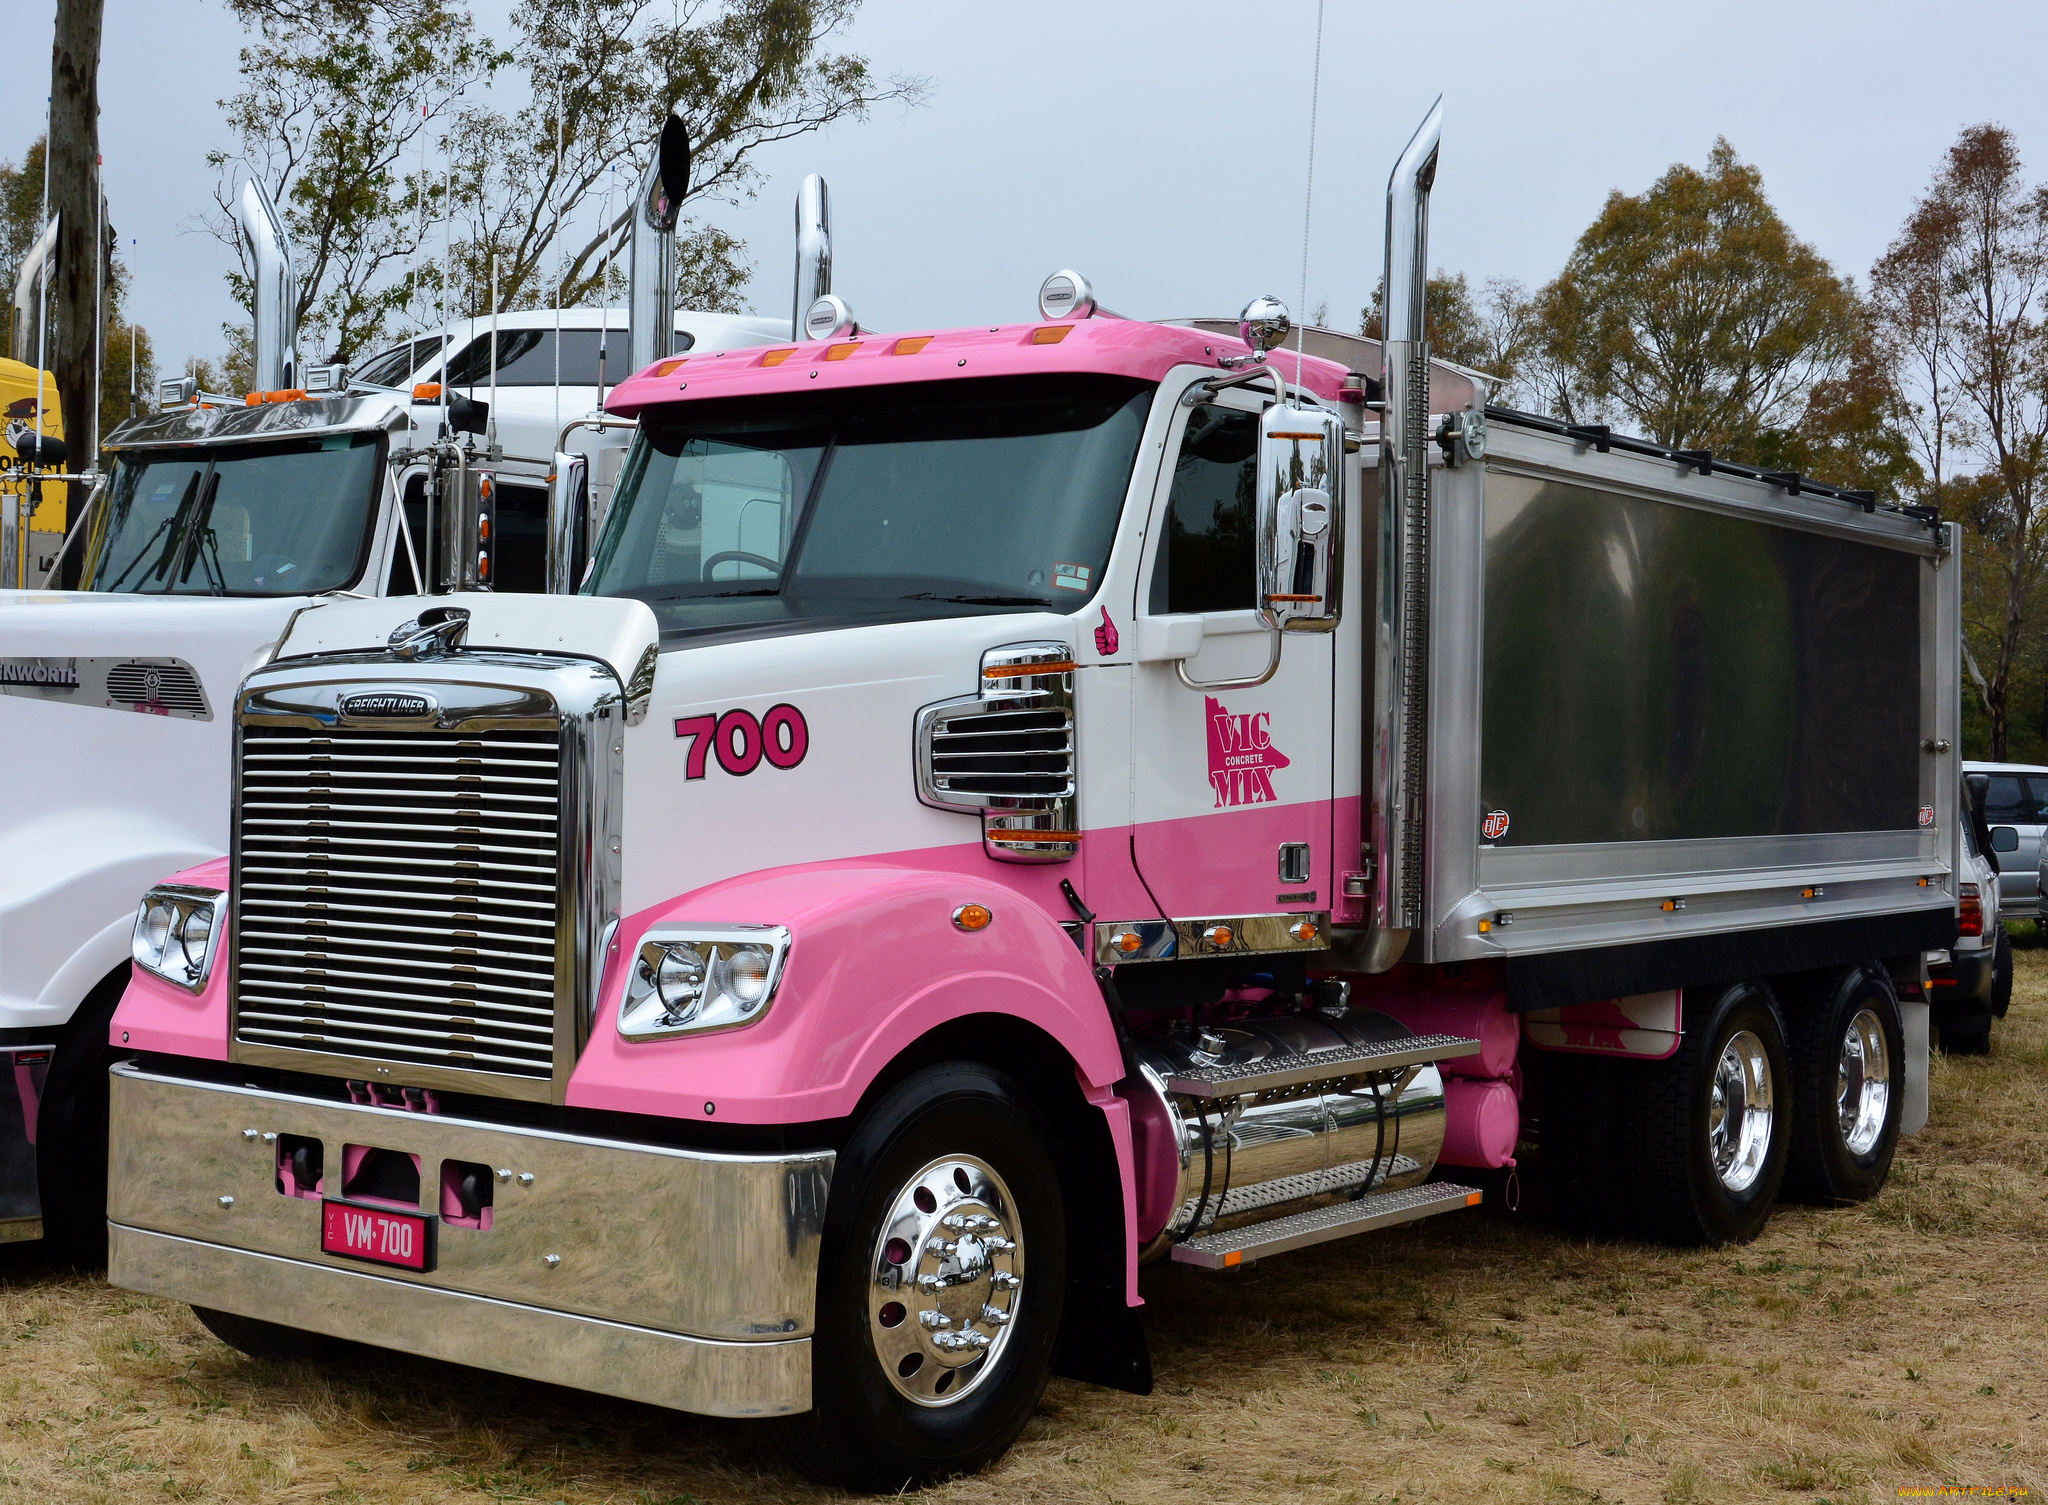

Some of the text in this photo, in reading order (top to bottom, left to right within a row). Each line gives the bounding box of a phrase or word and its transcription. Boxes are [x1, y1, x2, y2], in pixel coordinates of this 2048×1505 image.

[0, 664, 79, 684] NWORTH
[348, 698, 424, 713] FREIGHTLINER
[672, 703, 809, 782] 700
[1213, 711, 1271, 753] VIC
[1225, 753, 1264, 766] CONCRETE
[1212, 765, 1278, 808] MIX
